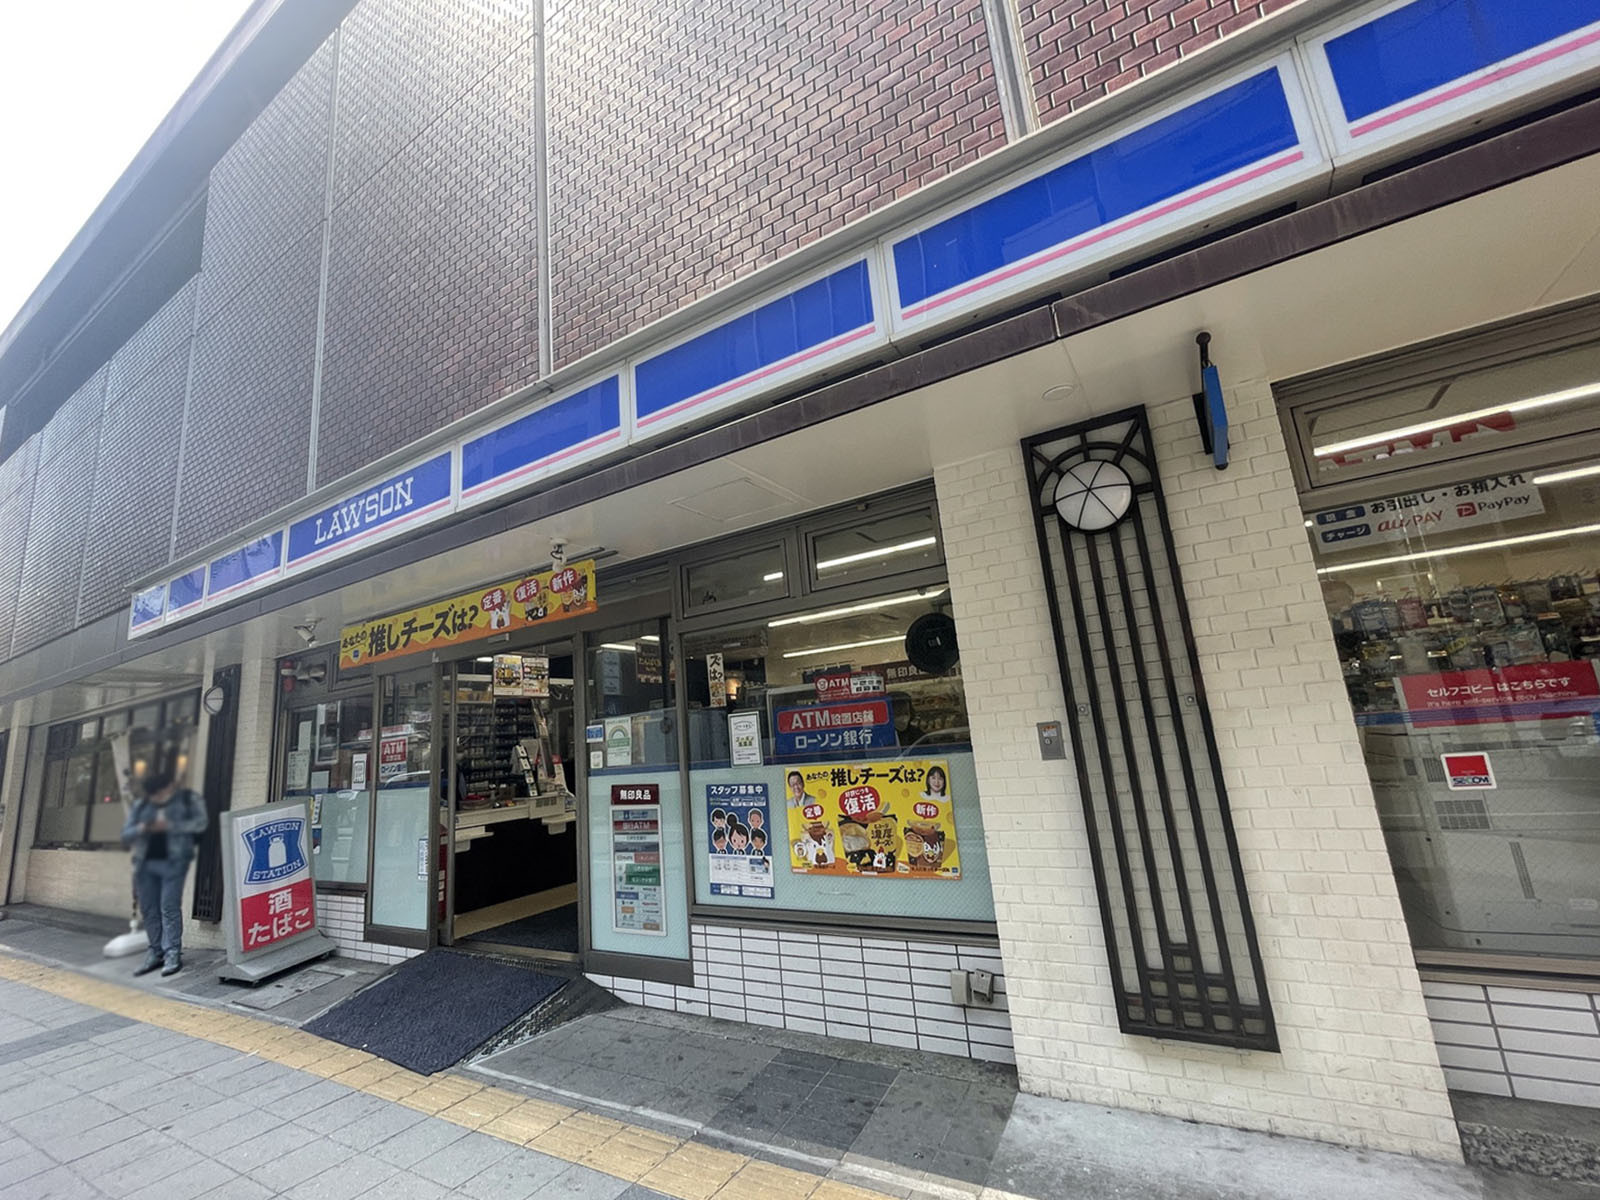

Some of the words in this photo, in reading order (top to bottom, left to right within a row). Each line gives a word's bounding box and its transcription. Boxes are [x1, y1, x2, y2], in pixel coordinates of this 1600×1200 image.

[314, 476, 414, 545] LAWSON
[1478, 494, 1531, 511] PayPay
[516, 579, 538, 602] 復活
[552, 569, 575, 592] 新作
[482, 590, 504, 611] 定番
[830, 676, 850, 689] ATM
[1427, 677, 1571, 698] セルフコピーはこちらです
[383, 740, 405, 755] ATM
[795, 728, 873, 750] ローソン銀行
[806, 770, 829, 781] あなたの
[619, 788, 651, 801] 無印良品
[710, 784, 764, 795] スタッフ募集中
[804, 805, 824, 819] 定番
[843, 793, 877, 815] 復活
[915, 804, 938, 819] 新作
[249, 822, 300, 842] LAWSON
[252, 859, 301, 880] STATION
[268, 888, 293, 916] 酒
[248, 907, 311, 946] たばこ
